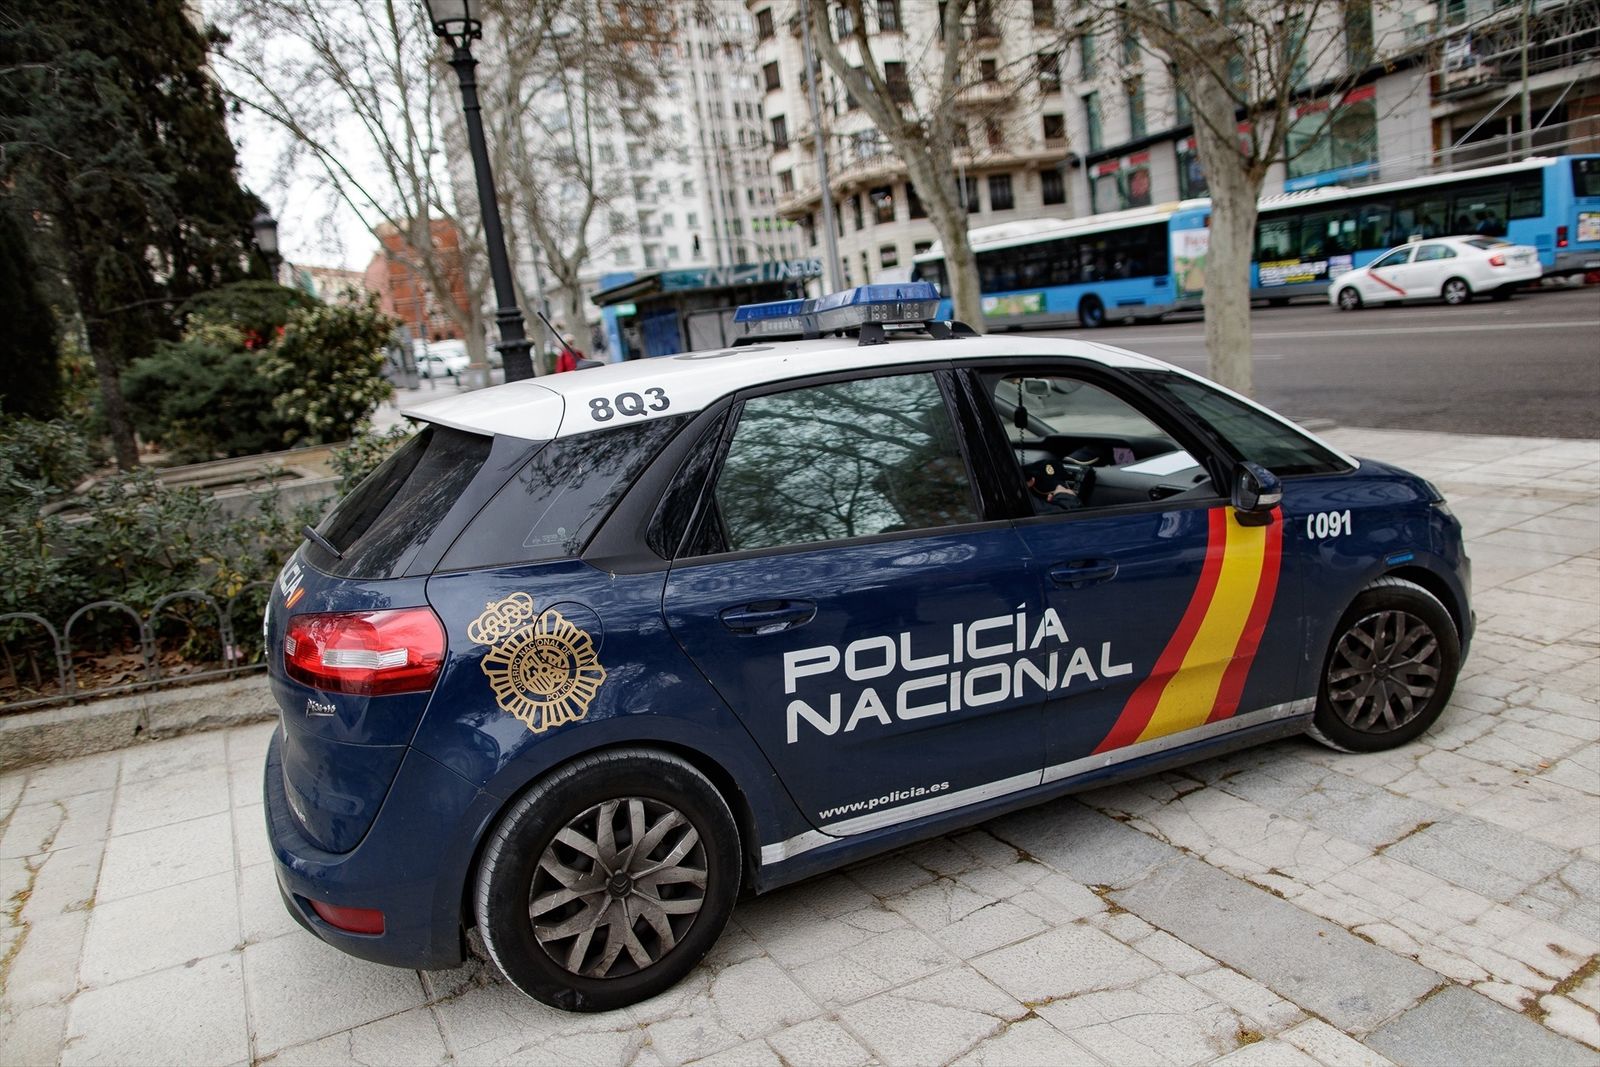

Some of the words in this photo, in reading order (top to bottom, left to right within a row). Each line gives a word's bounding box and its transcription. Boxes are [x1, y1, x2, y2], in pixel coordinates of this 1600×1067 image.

[588, 387, 671, 422] 8Q3
[518, 638, 560, 658] NACIONAL
[561, 645, 573, 657] DE
[783, 602, 1070, 695] POLICÍA
[512, 657, 527, 693] CUERPO
[786, 642, 1134, 744] NACIONAL
[818, 781, 951, 820] www.policia.es
